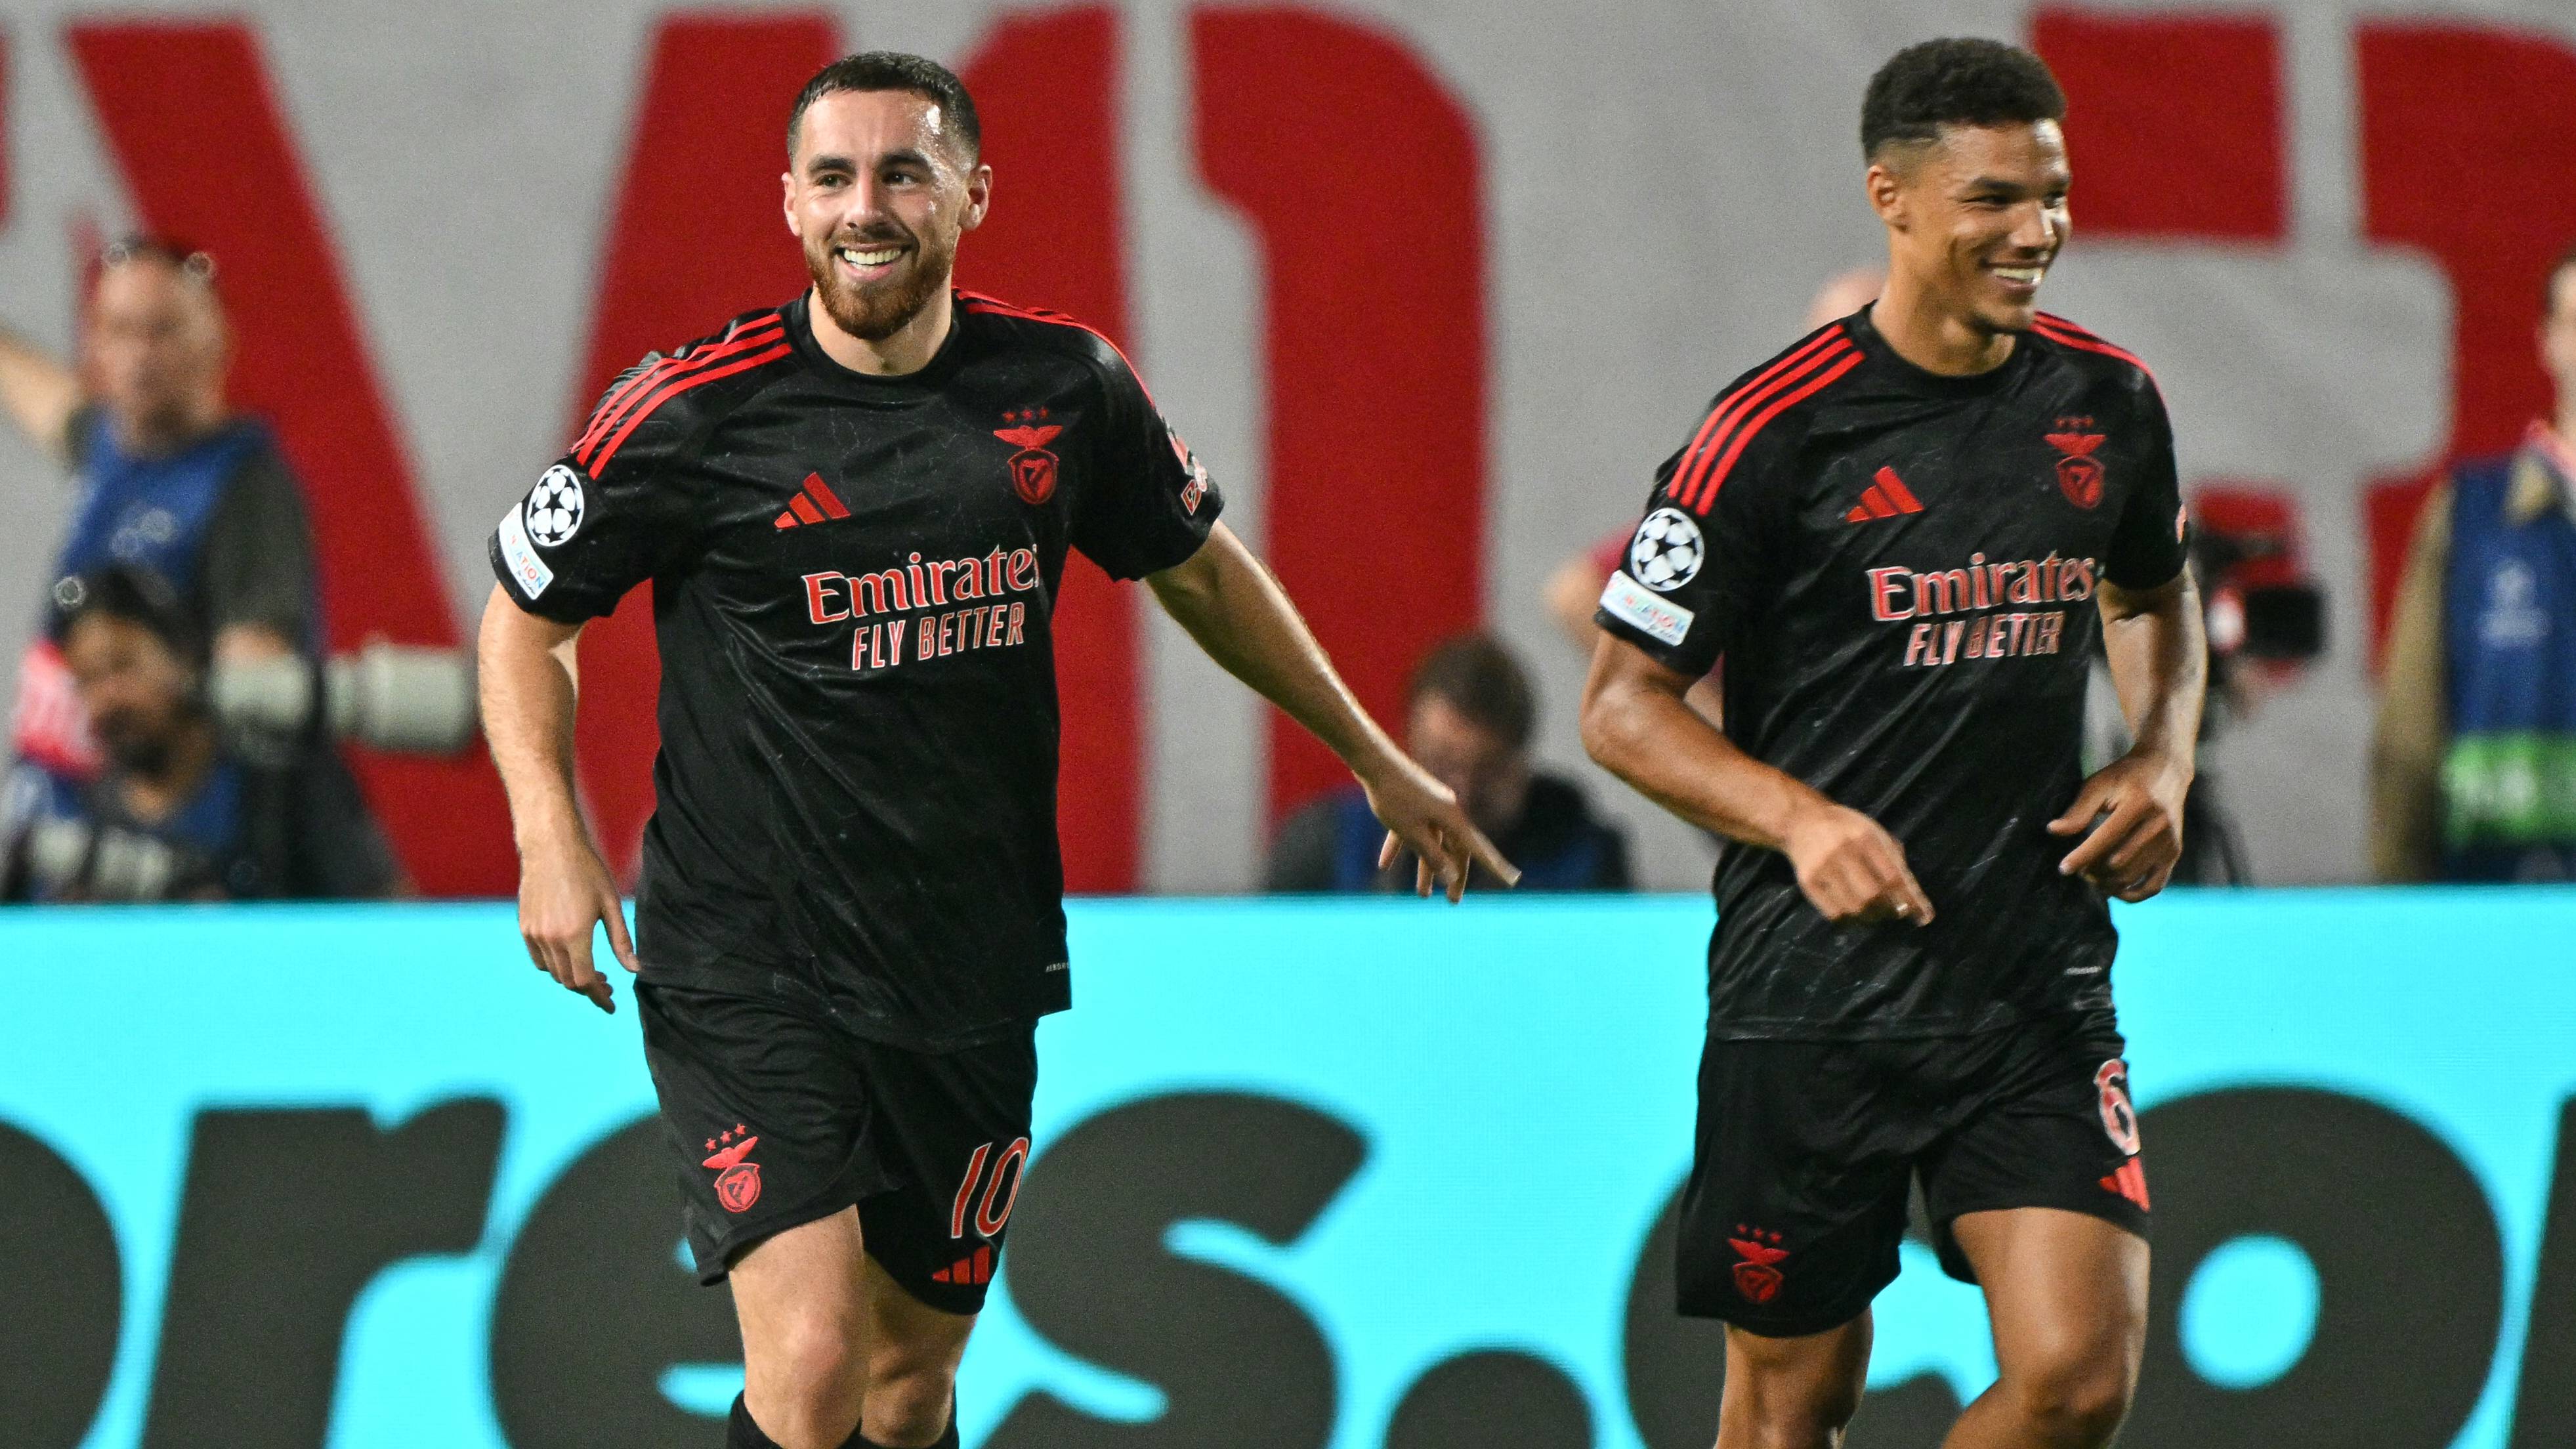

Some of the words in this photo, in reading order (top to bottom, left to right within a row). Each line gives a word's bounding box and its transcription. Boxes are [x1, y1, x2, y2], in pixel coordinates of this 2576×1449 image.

[801, 544, 1040, 625] Emirate
[1865, 550, 2096, 621] Emirates
[852, 620, 906, 671] FLY
[918, 602, 1025, 661] BETTER
[1903, 620, 1966, 667] FLY
[2093, 1059, 2141, 1156] 6
[951, 1137, 1029, 1239] 10
